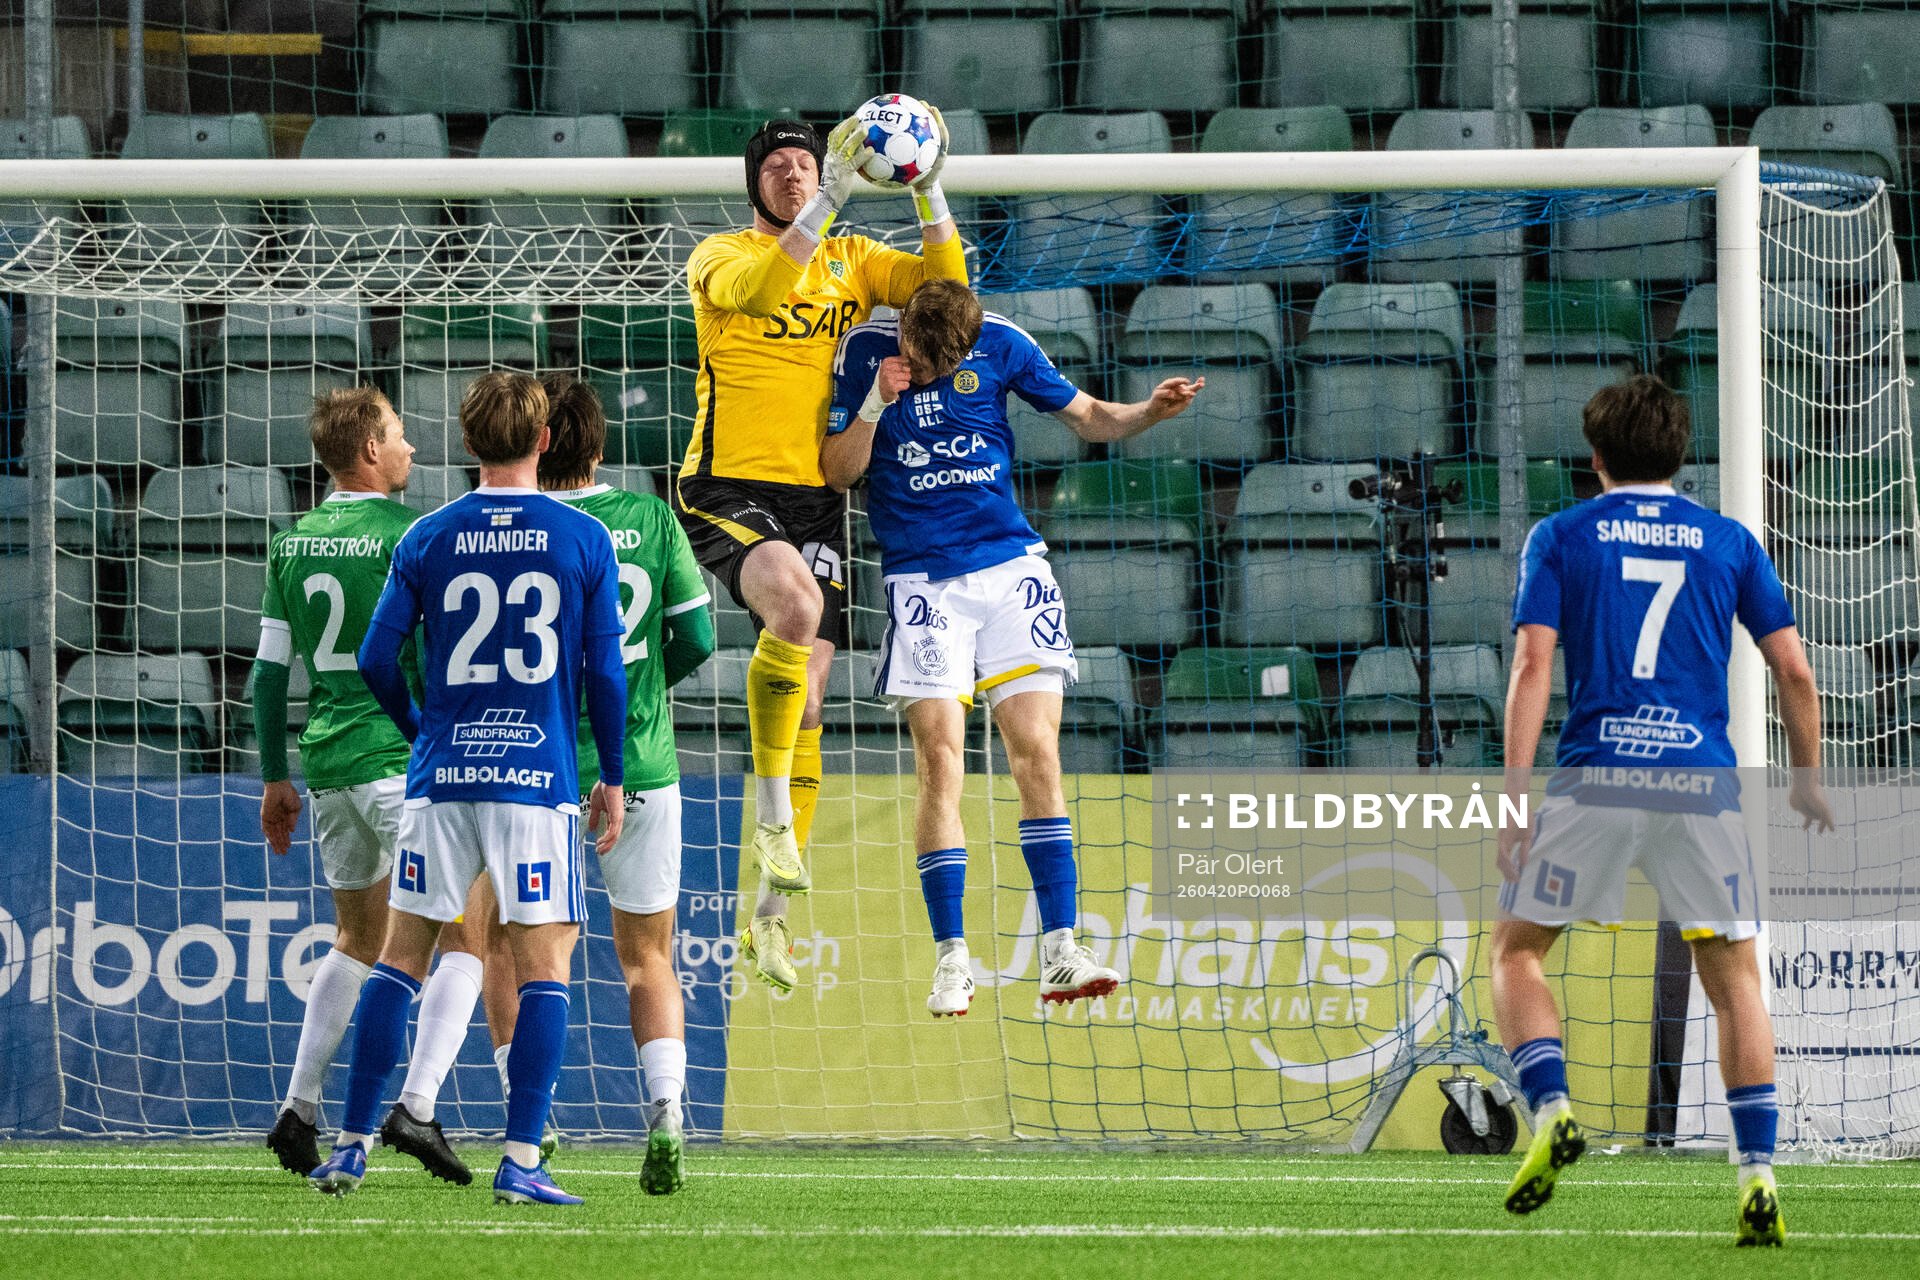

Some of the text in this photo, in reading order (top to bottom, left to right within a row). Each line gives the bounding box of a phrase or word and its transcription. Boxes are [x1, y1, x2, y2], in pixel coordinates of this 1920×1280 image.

[859, 110, 903, 124] ELECT
[763, 300, 858, 339] SSAB
[914, 391, 939, 404] SUN
[829, 411, 846, 422] BET
[918, 415, 943, 428] ALL
[933, 433, 987, 458] SCA
[910, 467, 996, 491] GOODWAY
[280, 534, 382, 558] LETTERSTRÖM
[455, 530, 548, 554] AVIANDER
[612, 529, 641, 549] RD
[1596, 519, 1703, 549] SANDBERG
[1016, 576, 1063, 609] Diö
[303, 572, 357, 671] 2
[905, 595, 948, 631] Diös
[1622, 555, 1686, 679] 7
[444, 571, 561, 686] 23
[460, 728, 532, 741] SUNDFRAKT
[1608, 723, 1686, 742] SUNDFRAKT
[435, 766, 554, 789] BILBOLAGET
[1582, 766, 1714, 795] BILBOLAGET
[690, 893, 746, 917] part
[1033, 996, 1369, 1022] STADMASKINER
